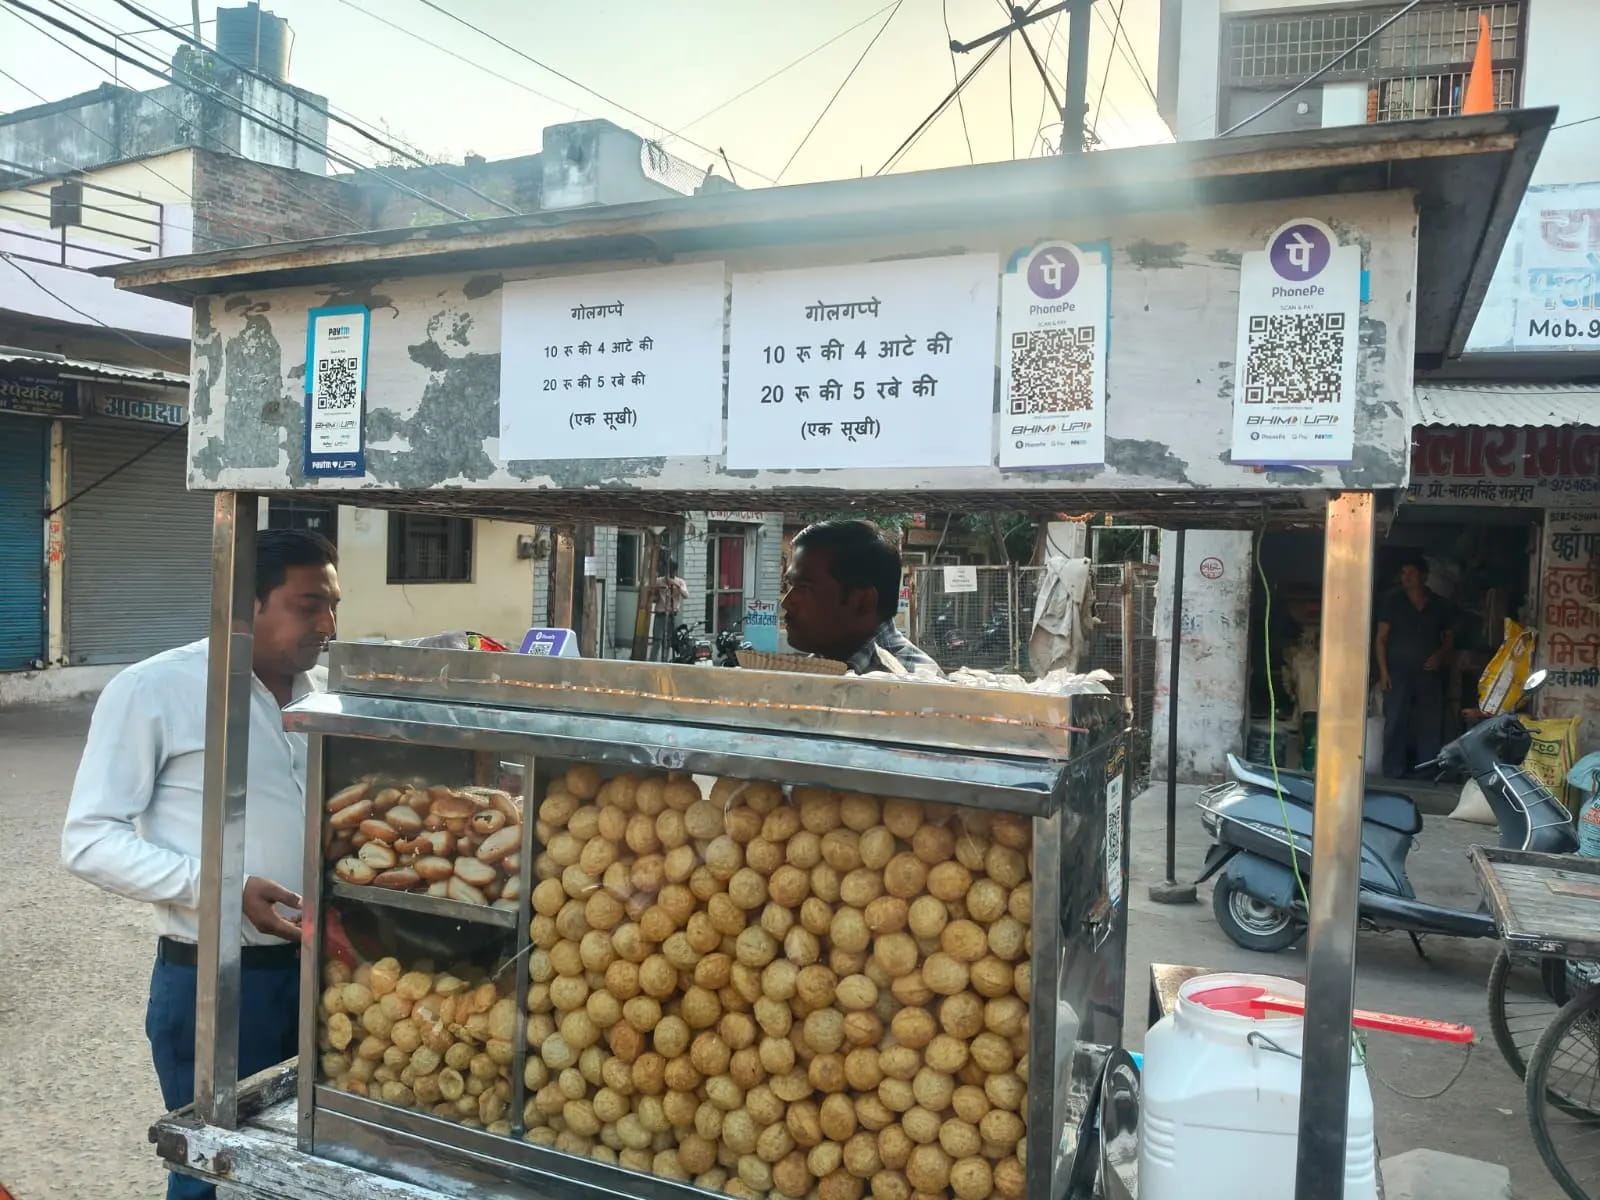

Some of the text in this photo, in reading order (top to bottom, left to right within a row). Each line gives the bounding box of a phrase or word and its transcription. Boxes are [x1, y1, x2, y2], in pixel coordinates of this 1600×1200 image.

[1272, 285, 1325, 298] PhonePe
[571, 300, 624, 320] गोलगप्पे
[805, 296, 881, 321] गोलगप्पे
[1029, 302, 1076, 315] PhonePe
[544, 345, 558, 358] 10
[578, 341, 592, 355] की
[598, 342, 605, 354] 4
[611, 338, 633, 353] आटे
[639, 336, 653, 351] की
[763, 345, 785, 364] 10
[821, 338, 844, 360] की
[855, 340, 866, 359] 4
[878, 334, 916, 358] आटे
[927, 331, 952, 355] की
[543, 379, 557, 391] 20
[577, 374, 592, 388] की
[597, 376, 604, 388] 5
[611, 373, 625, 387] रबे
[631, 371, 646, 385] की
[760, 385, 784, 403] 20
[819, 379, 843, 400] की
[853, 381, 864, 400] 5
[877, 376, 901, 399] रबे
[912, 374, 938, 397] की
[569, 407, 637, 431] (एक सूखी)
[801, 416, 881, 442] (एक सूखी)
[1011, 422, 1087, 434] BHIM UPI
[1247, 415, 1334, 425] BHIM UPI
